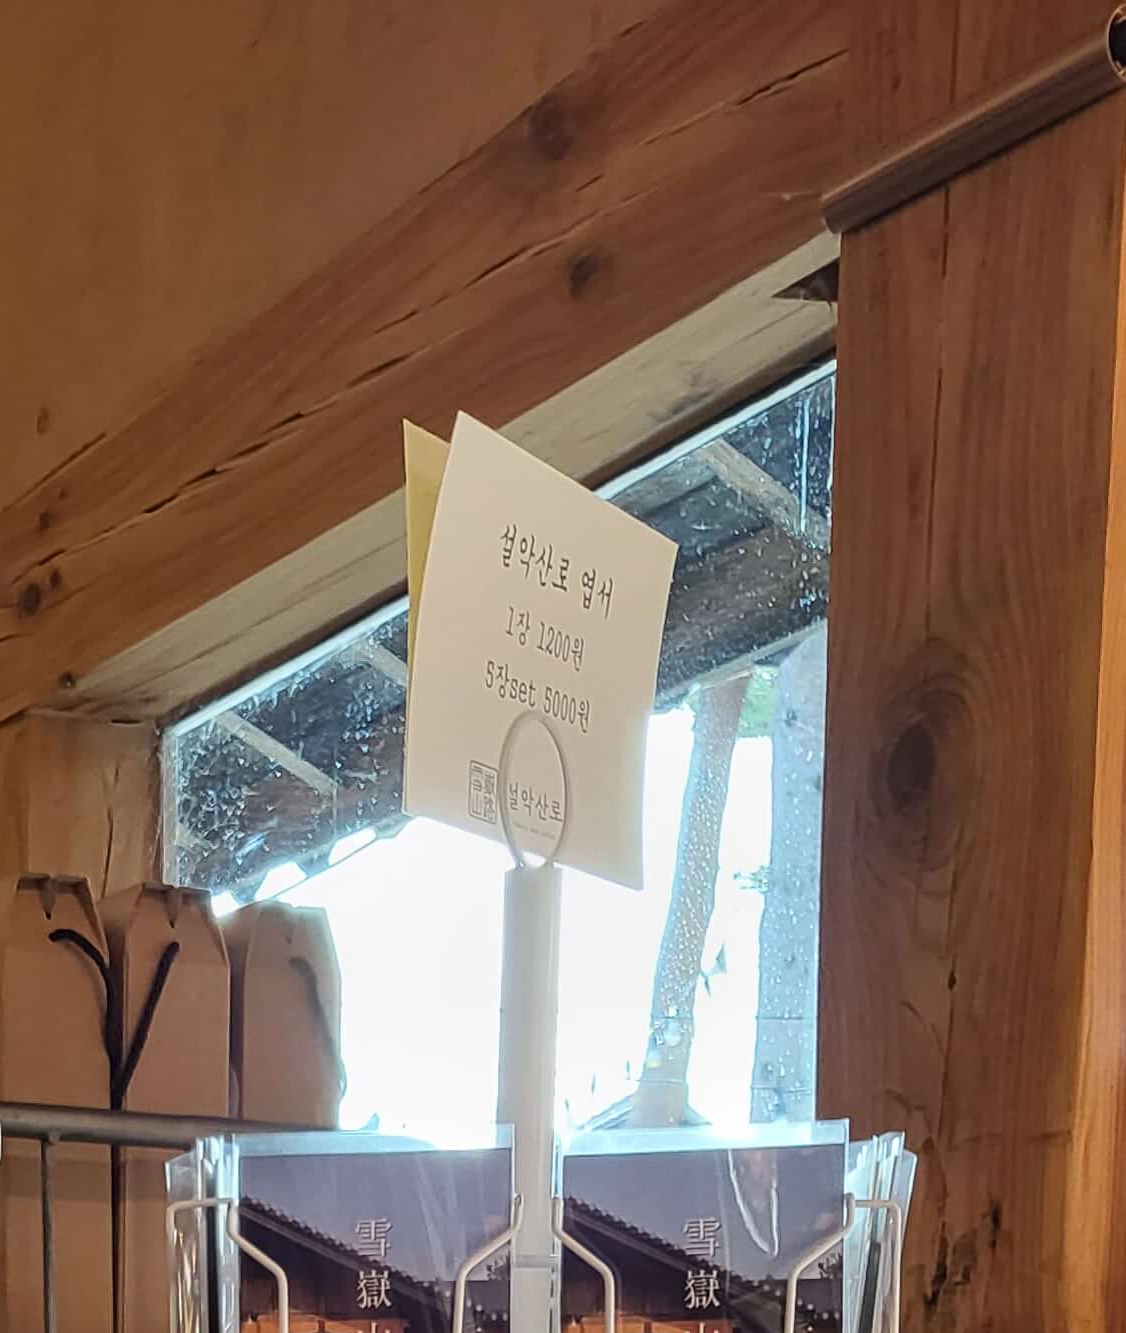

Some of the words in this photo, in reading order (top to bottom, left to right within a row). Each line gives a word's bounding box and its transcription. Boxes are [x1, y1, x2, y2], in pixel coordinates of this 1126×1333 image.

[500, 524, 569, 593] 설악산로
[581, 568, 613, 619] 엽서
[504, 606, 531, 647] 1장
[536, 622, 585, 673] 1200원
[485, 660, 536, 707] 5장set
[543, 686, 590, 734] 5000원
